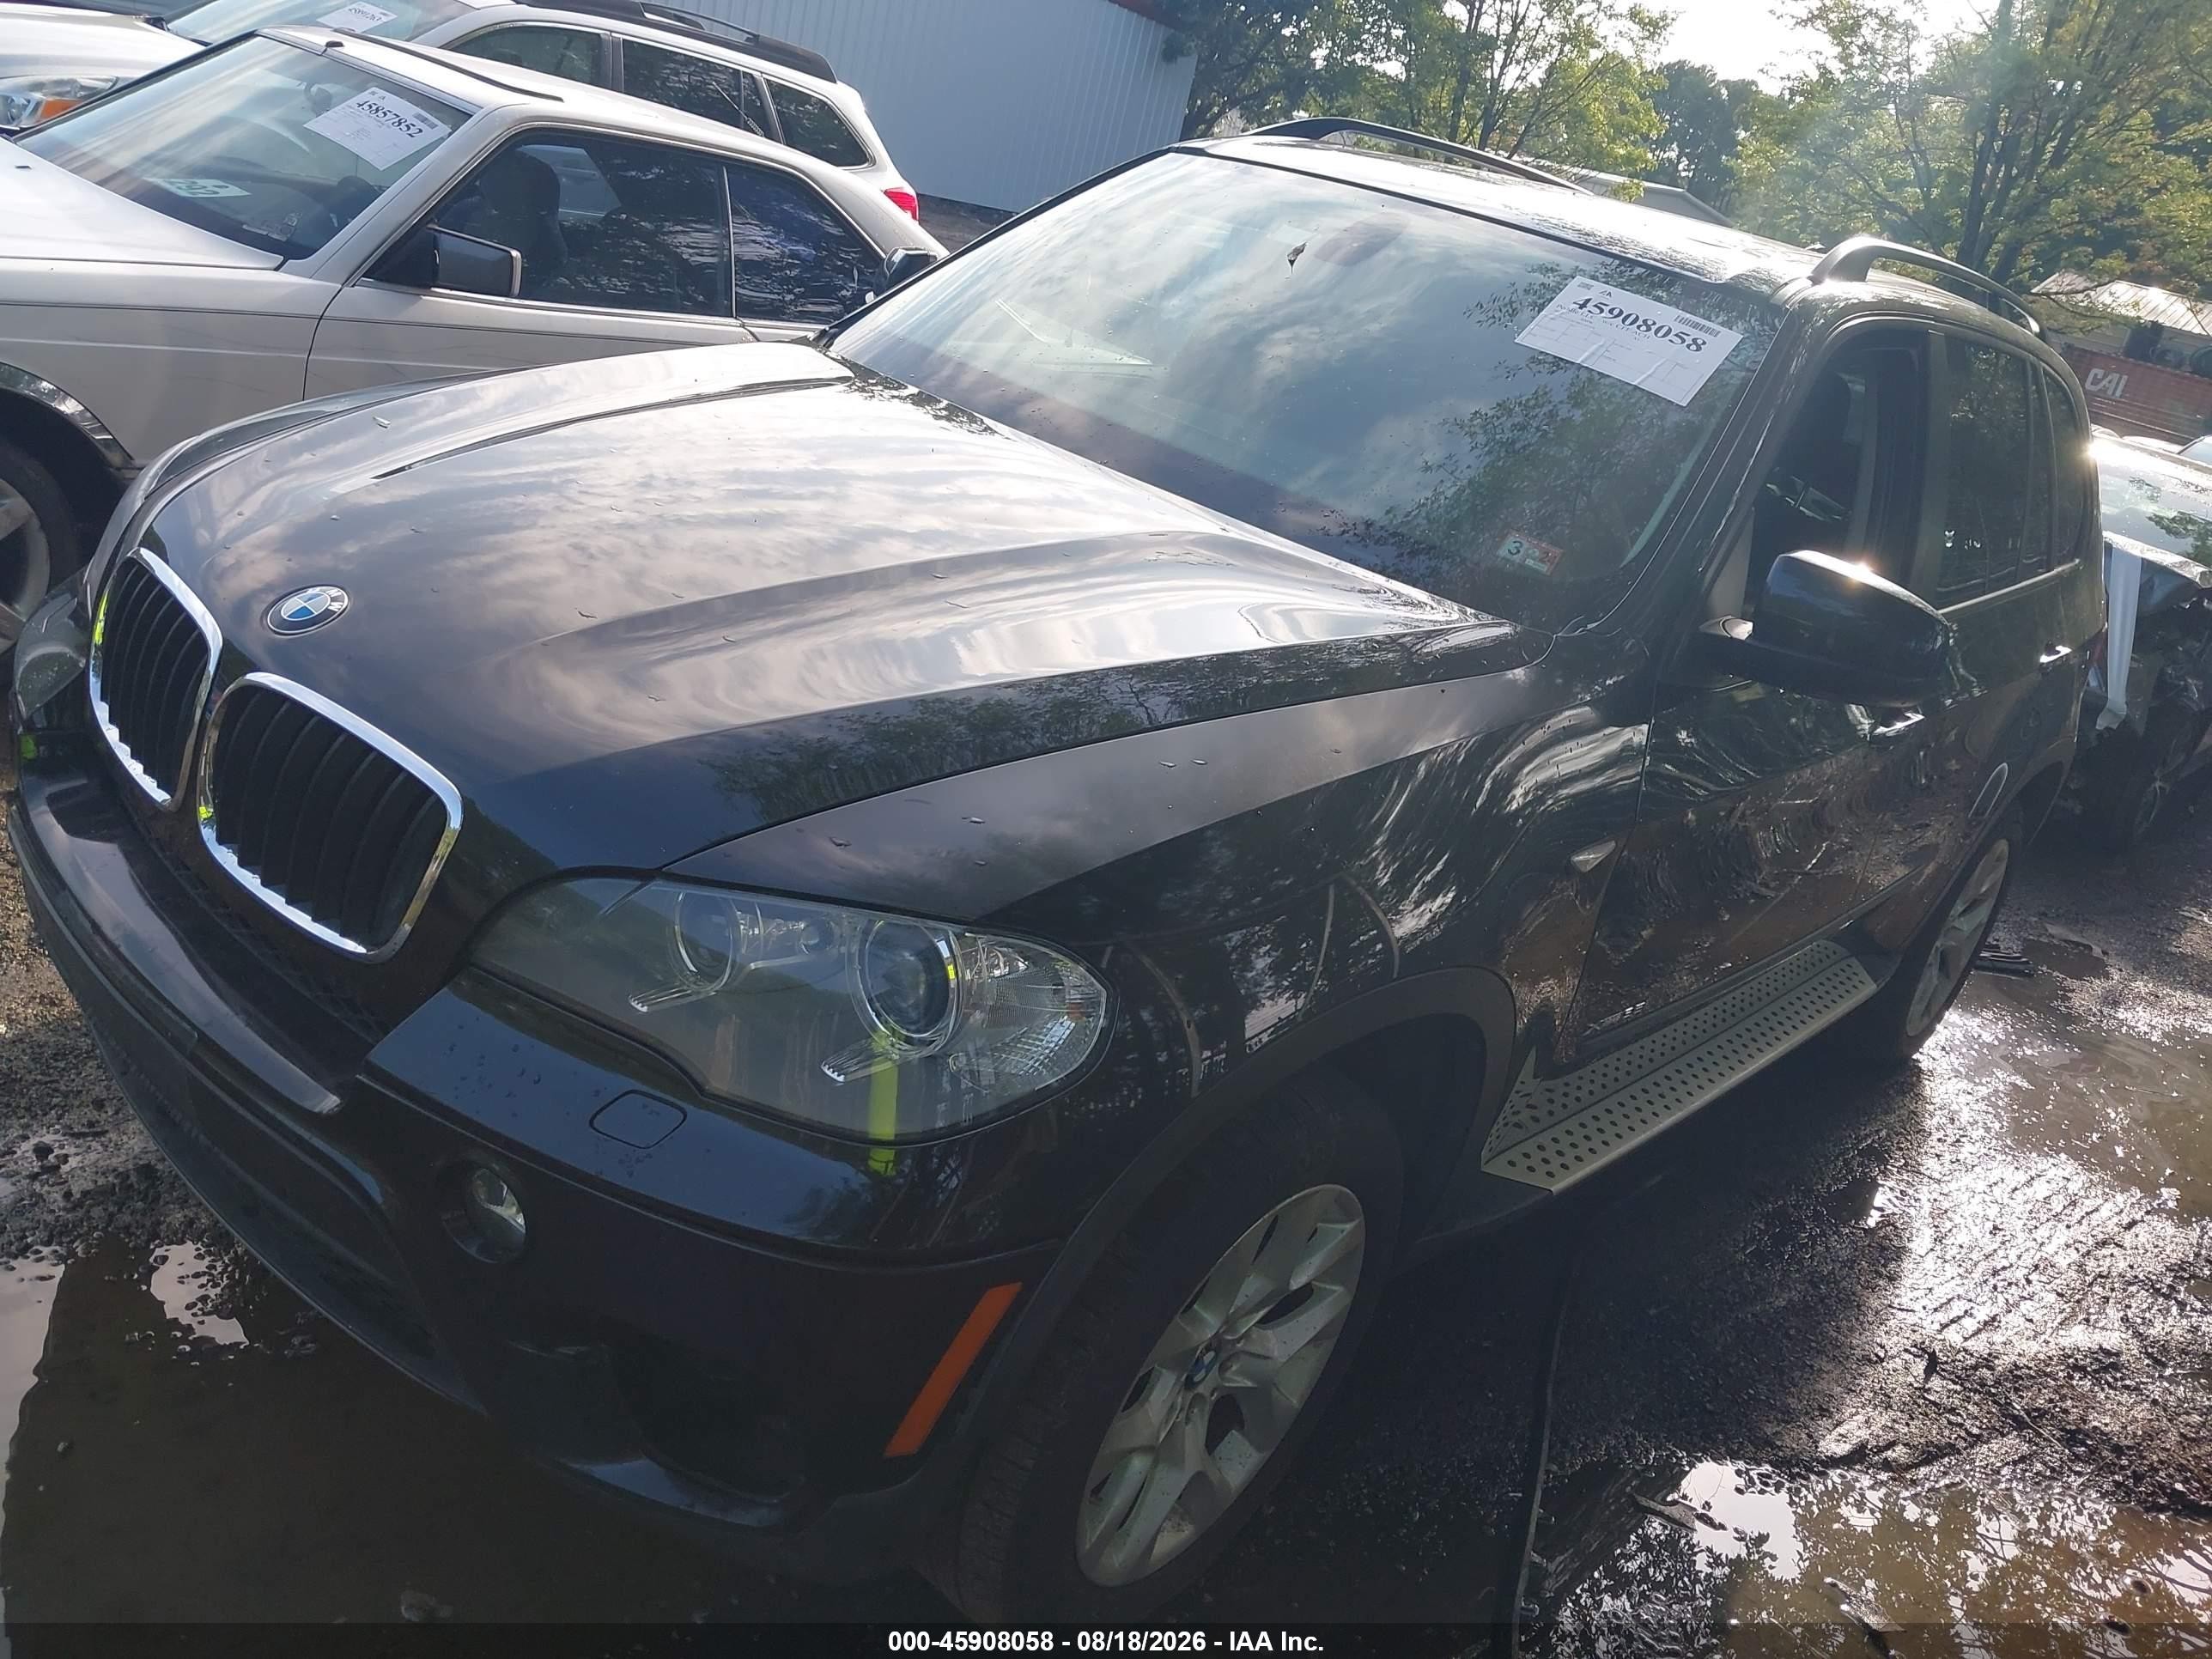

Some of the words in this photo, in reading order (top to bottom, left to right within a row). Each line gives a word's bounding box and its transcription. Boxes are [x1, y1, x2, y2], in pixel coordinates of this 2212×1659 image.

[356, 100, 424, 138] 45857852
[1572, 296, 1708, 353] 45908058
[1507, 540, 1524, 556] 3
